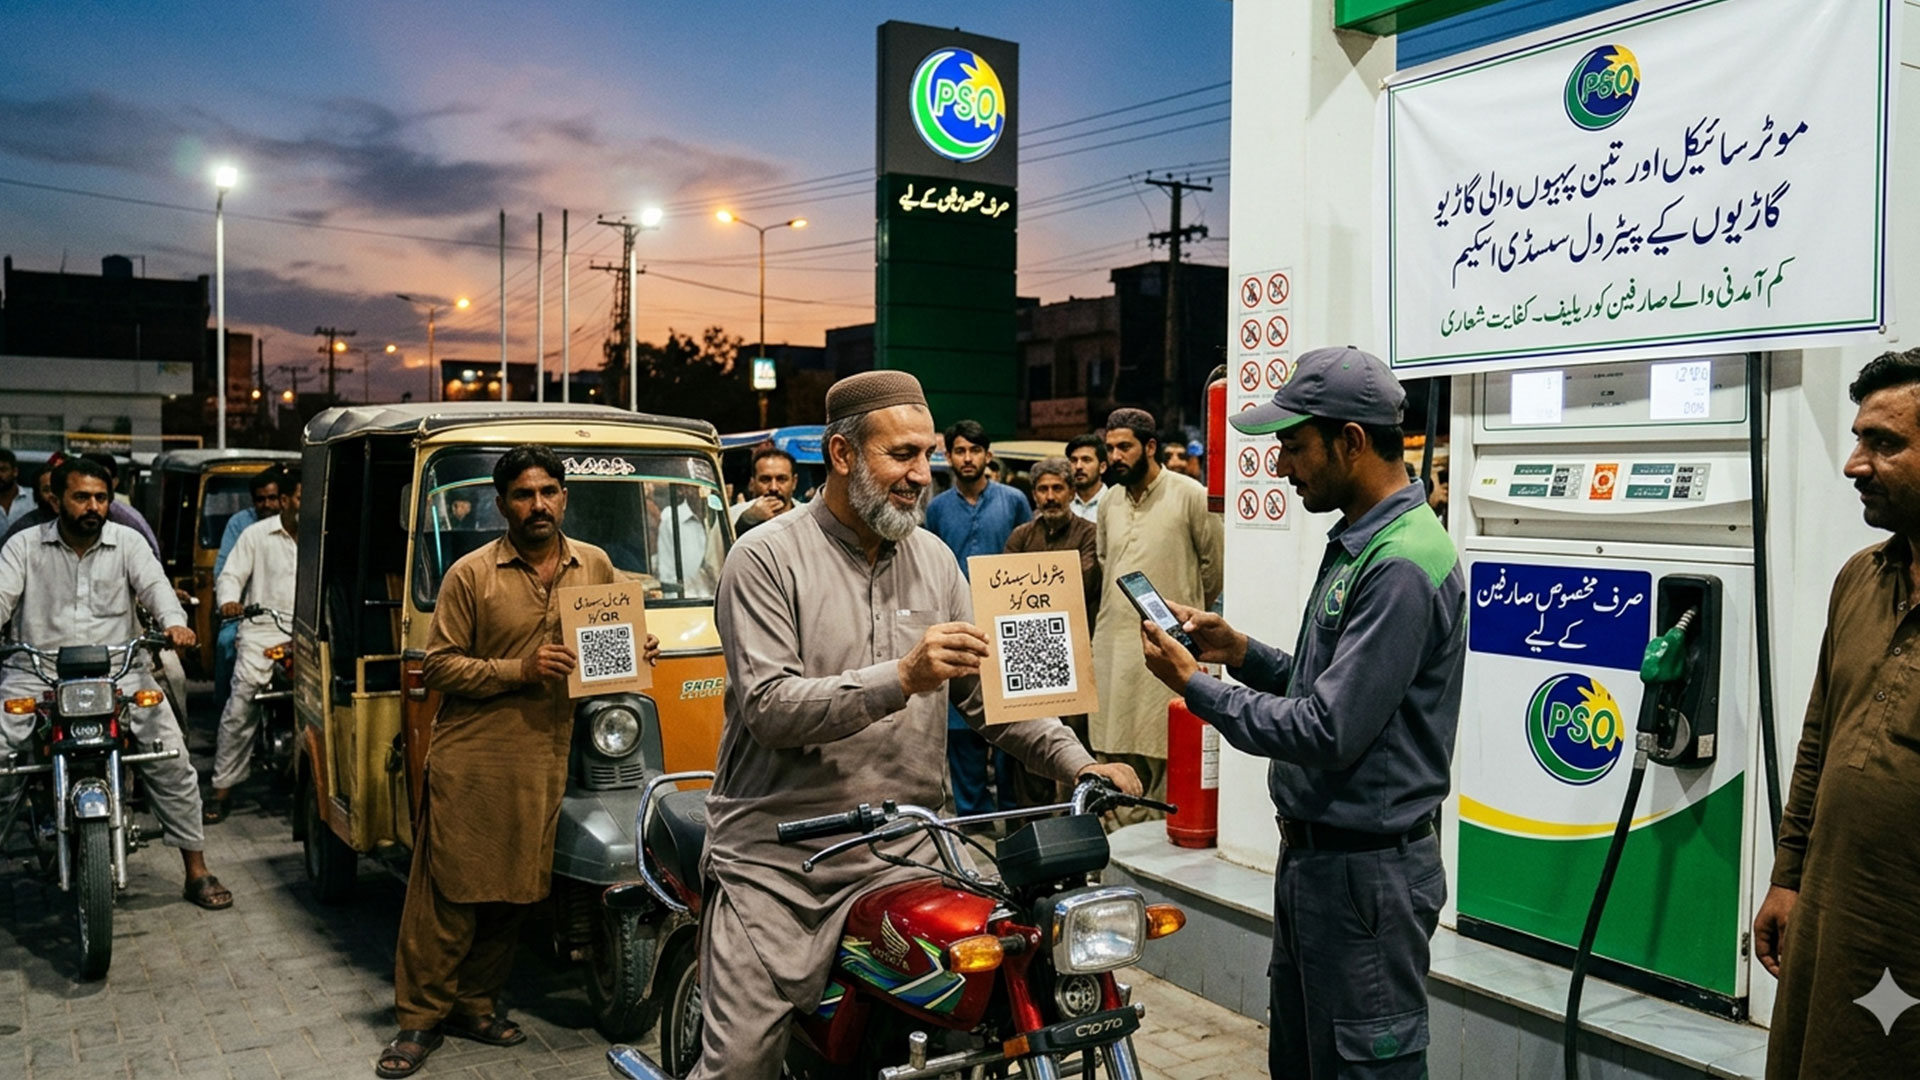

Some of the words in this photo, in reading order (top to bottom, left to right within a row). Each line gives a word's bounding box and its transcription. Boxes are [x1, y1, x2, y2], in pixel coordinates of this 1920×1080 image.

[935, 79, 998, 124] PSO
[1580, 141, 1624, 198] تین
[1625, 147, 1659, 184] اور
[1479, 170, 1514, 216] والی
[1517, 164, 1577, 209] پہیوں
[1692, 180, 1791, 245] گاڑیوں
[1452, 220, 1496, 289] اسکیم
[1569, 213, 1643, 262] پیٹرول
[1592, 283, 1613, 318] کو
[1607, 277, 1668, 319] صارفین
[1669, 280, 1714, 309] والے
[1717, 266, 1768, 308] آمدنی
[1767, 256, 1796, 308] کم
[1441, 305, 1485, 337] شعاری
[1486, 295, 1538, 329] کفایت
[1026, 593, 1051, 609] QR
[1477, 567, 1534, 608] صارفین
[1535, 575, 1599, 612] مخصوص
[1592, 586, 1644, 618] صرف
[600, 611, 620, 622] QR
[1524, 613, 1556, 652] لیے
[1558, 619, 1588, 649] کے
[1547, 701, 1617, 747] PSO
